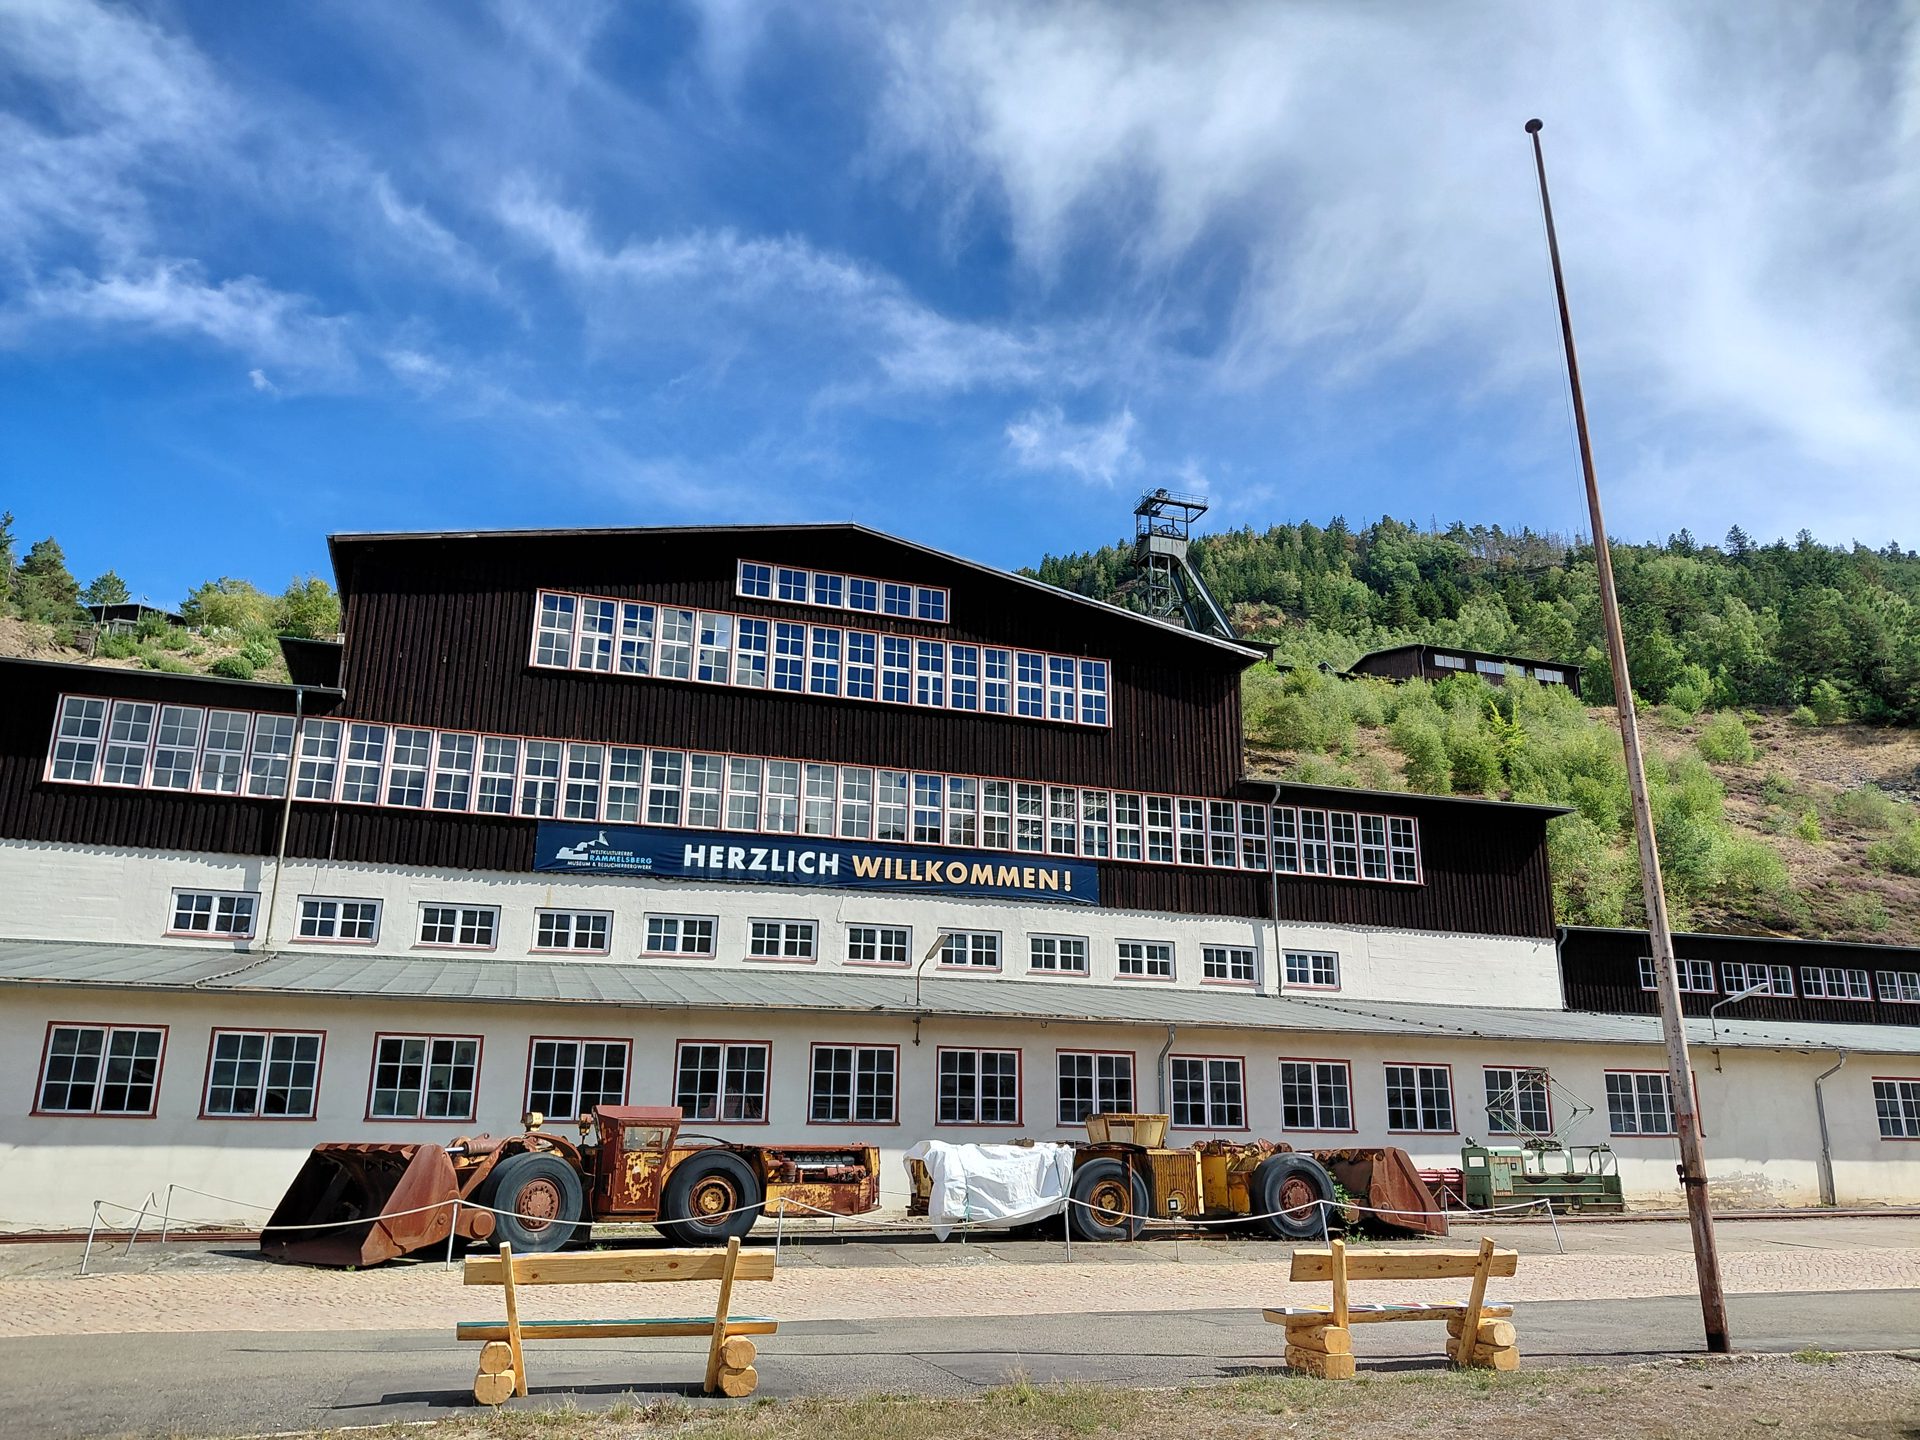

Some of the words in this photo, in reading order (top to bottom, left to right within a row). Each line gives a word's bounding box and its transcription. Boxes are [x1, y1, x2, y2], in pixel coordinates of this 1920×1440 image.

[590, 849, 633, 857] WELTKULTURERBE
[590, 855, 652, 864] RAMMELSBERG
[598, 862, 652, 870] BESUCHERBERGWERK
[683, 843, 840, 876] HERZLICH
[852, 855, 1072, 892] WILLKOMMEN!
